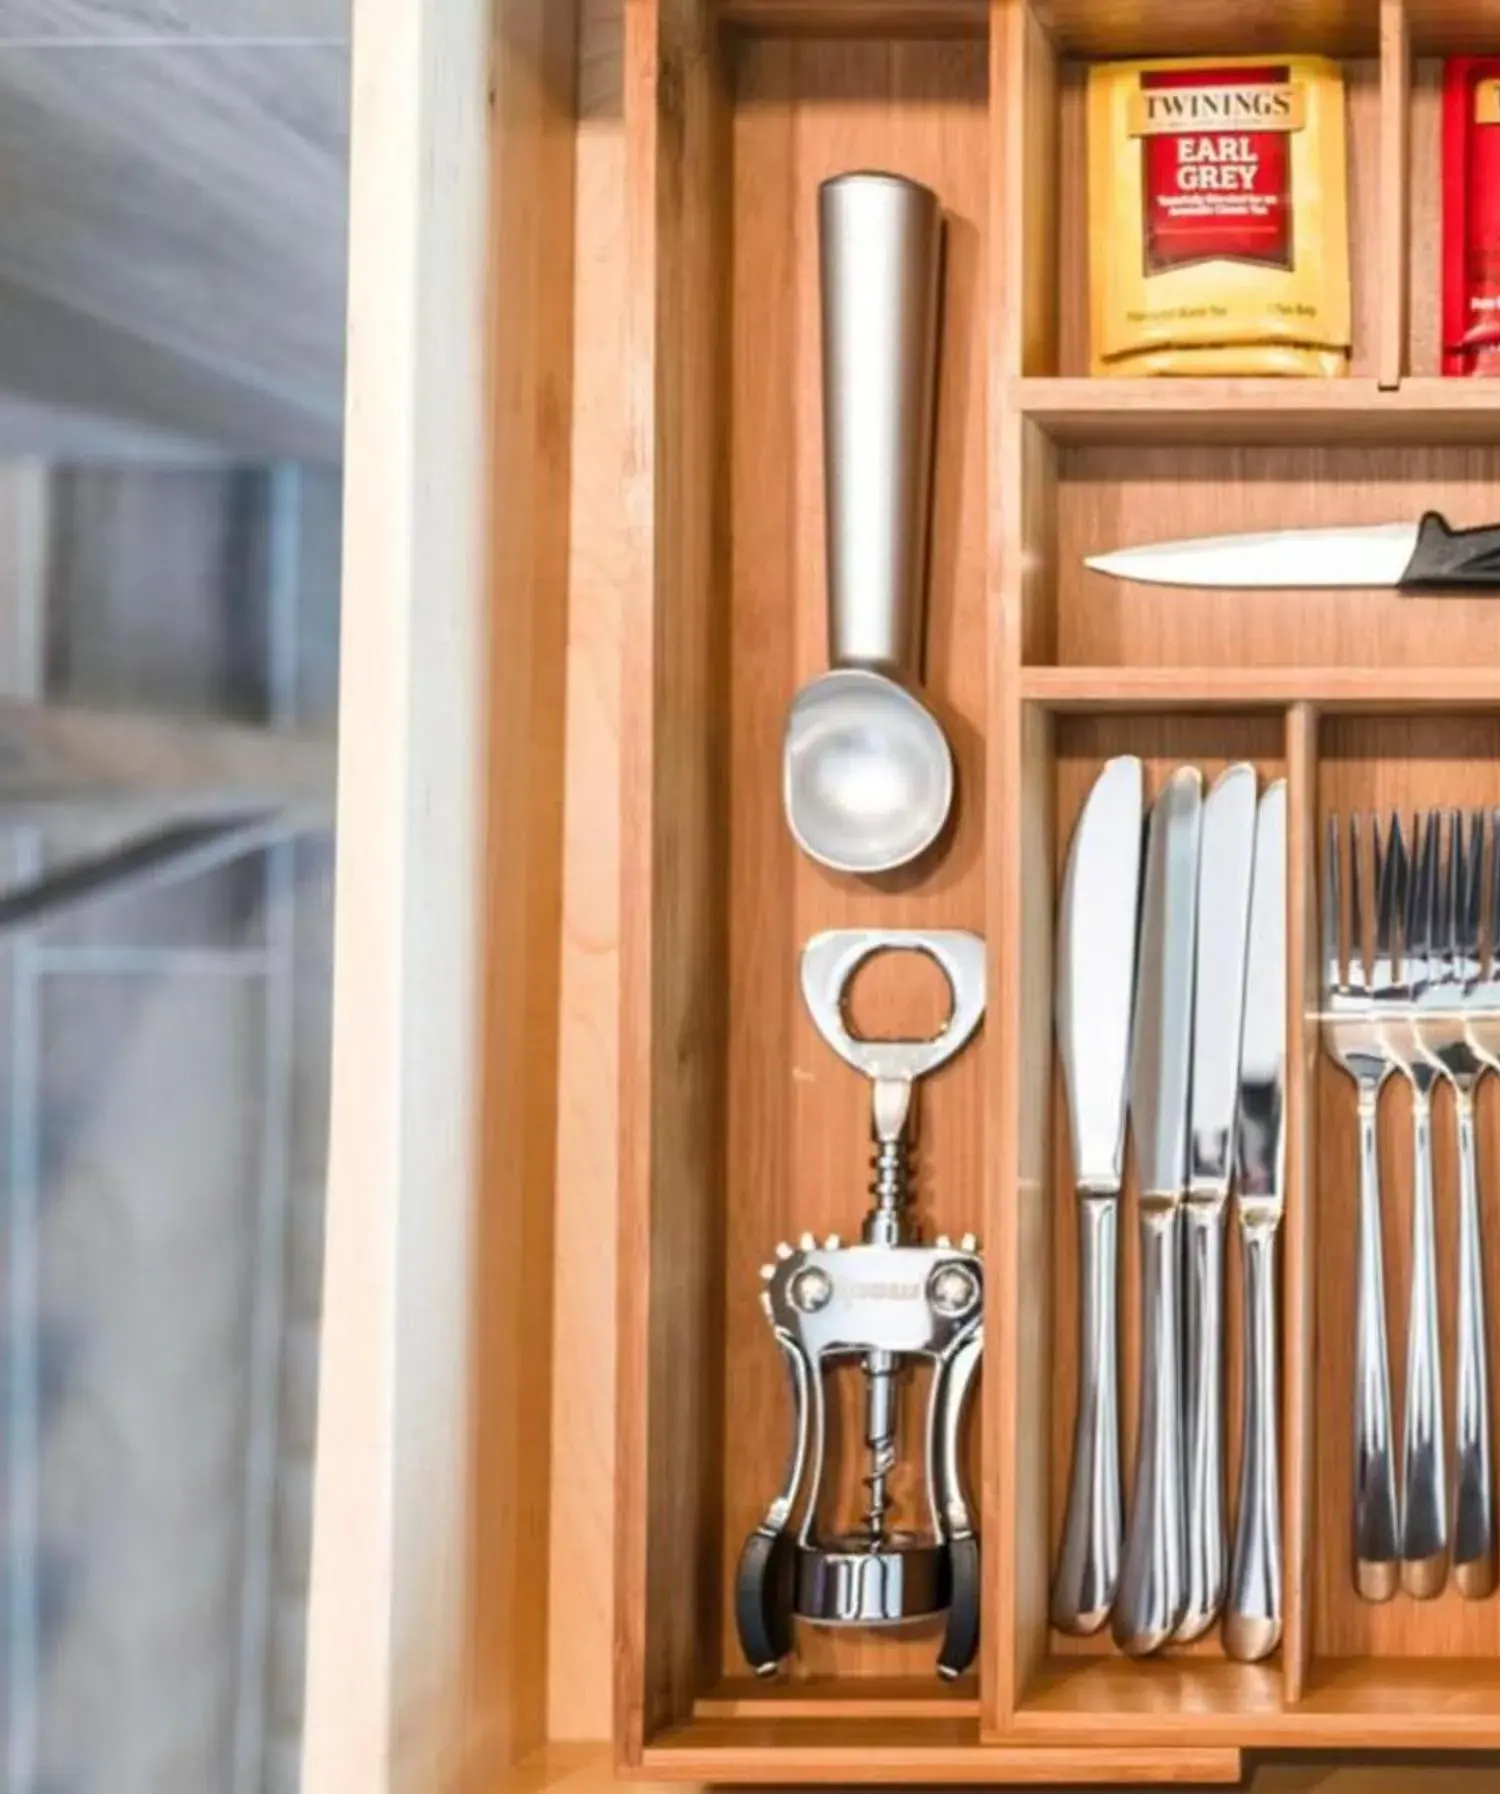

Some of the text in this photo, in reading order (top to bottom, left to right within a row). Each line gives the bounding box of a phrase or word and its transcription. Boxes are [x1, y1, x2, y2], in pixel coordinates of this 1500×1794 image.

[1142, 91, 1291, 120] TWININGS
[1176, 136, 1259, 163] EARL
[1176, 164, 1260, 191] GREY
